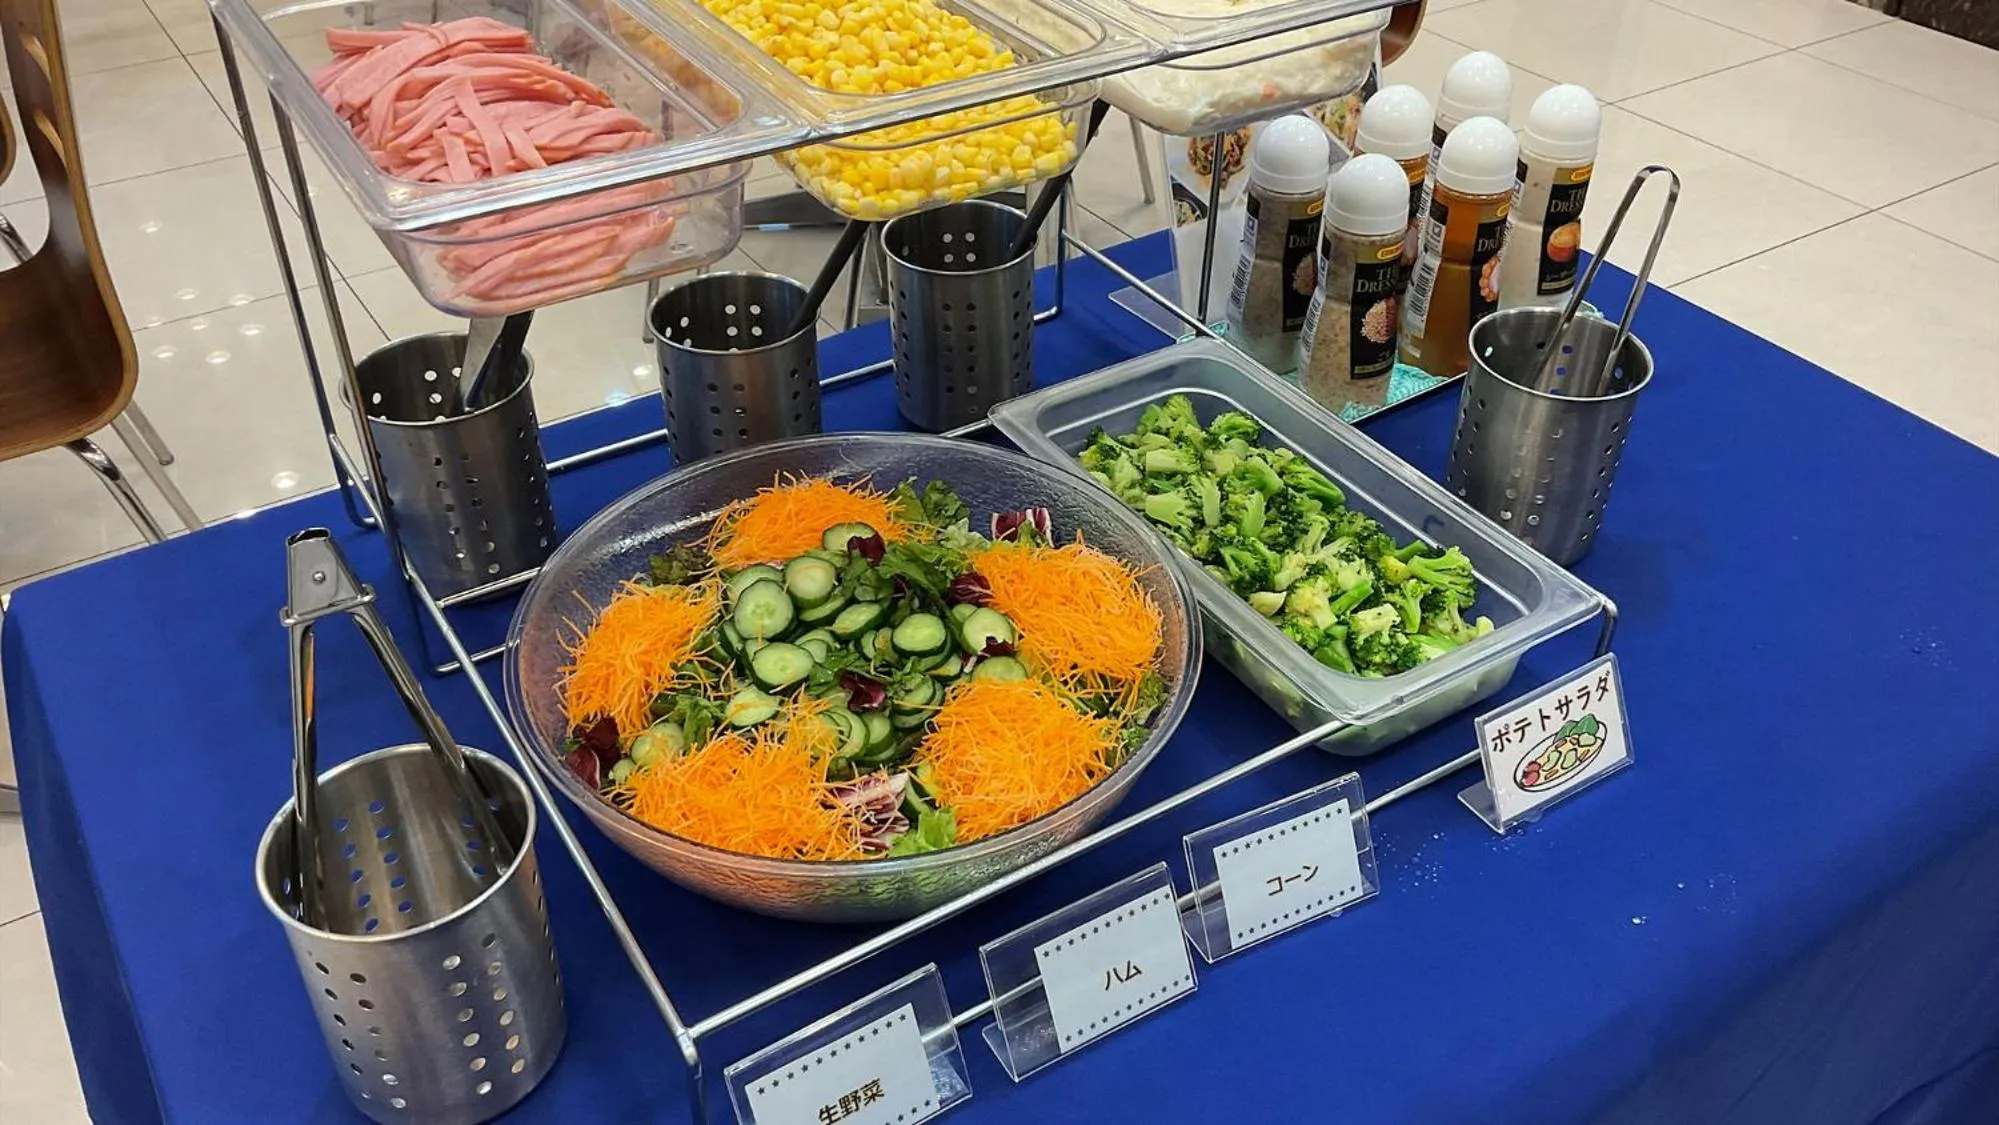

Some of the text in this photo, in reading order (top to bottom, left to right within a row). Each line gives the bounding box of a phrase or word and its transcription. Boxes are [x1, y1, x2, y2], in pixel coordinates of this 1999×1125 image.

[1491, 670, 1610, 752] ポテトサラダ
[1266, 865, 1318, 896] コーン
[1105, 960, 1143, 991] ハム
[818, 1077, 884, 1125] 生野菜
